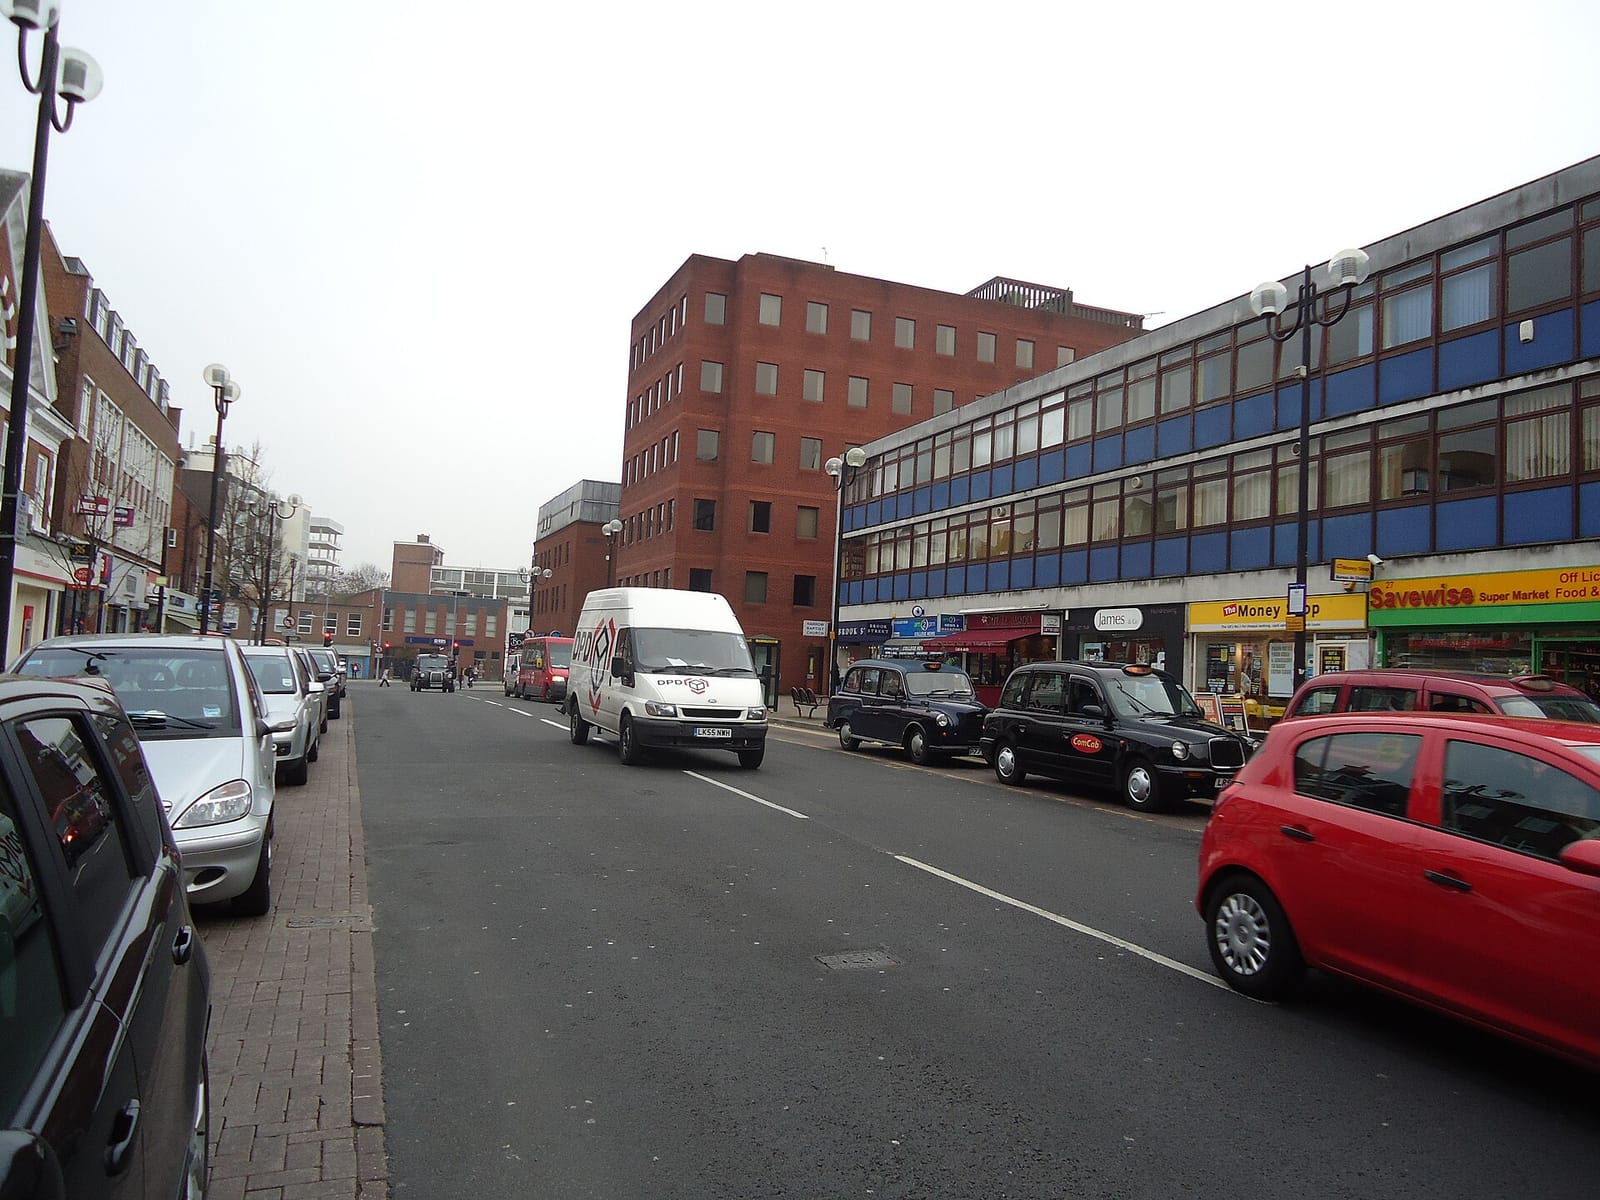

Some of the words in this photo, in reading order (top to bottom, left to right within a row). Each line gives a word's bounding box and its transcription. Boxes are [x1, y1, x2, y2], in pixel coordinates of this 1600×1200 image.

[1559, 572, 1578, 583] Off
[1370, 584, 1474, 609] Savewise
[1479, 592, 1510, 603] Super
[1512, 590, 1550, 601] Market
[1555, 586, 1587, 598] Food
[1224, 604, 1237, 615] The
[1238, 604, 1281, 619] Money
[1286, 604, 1320, 618] op
[1098, 612, 1126, 628] James
[572, 631, 593, 662] DPD
[1073, 737, 1100, 749] ComCab
